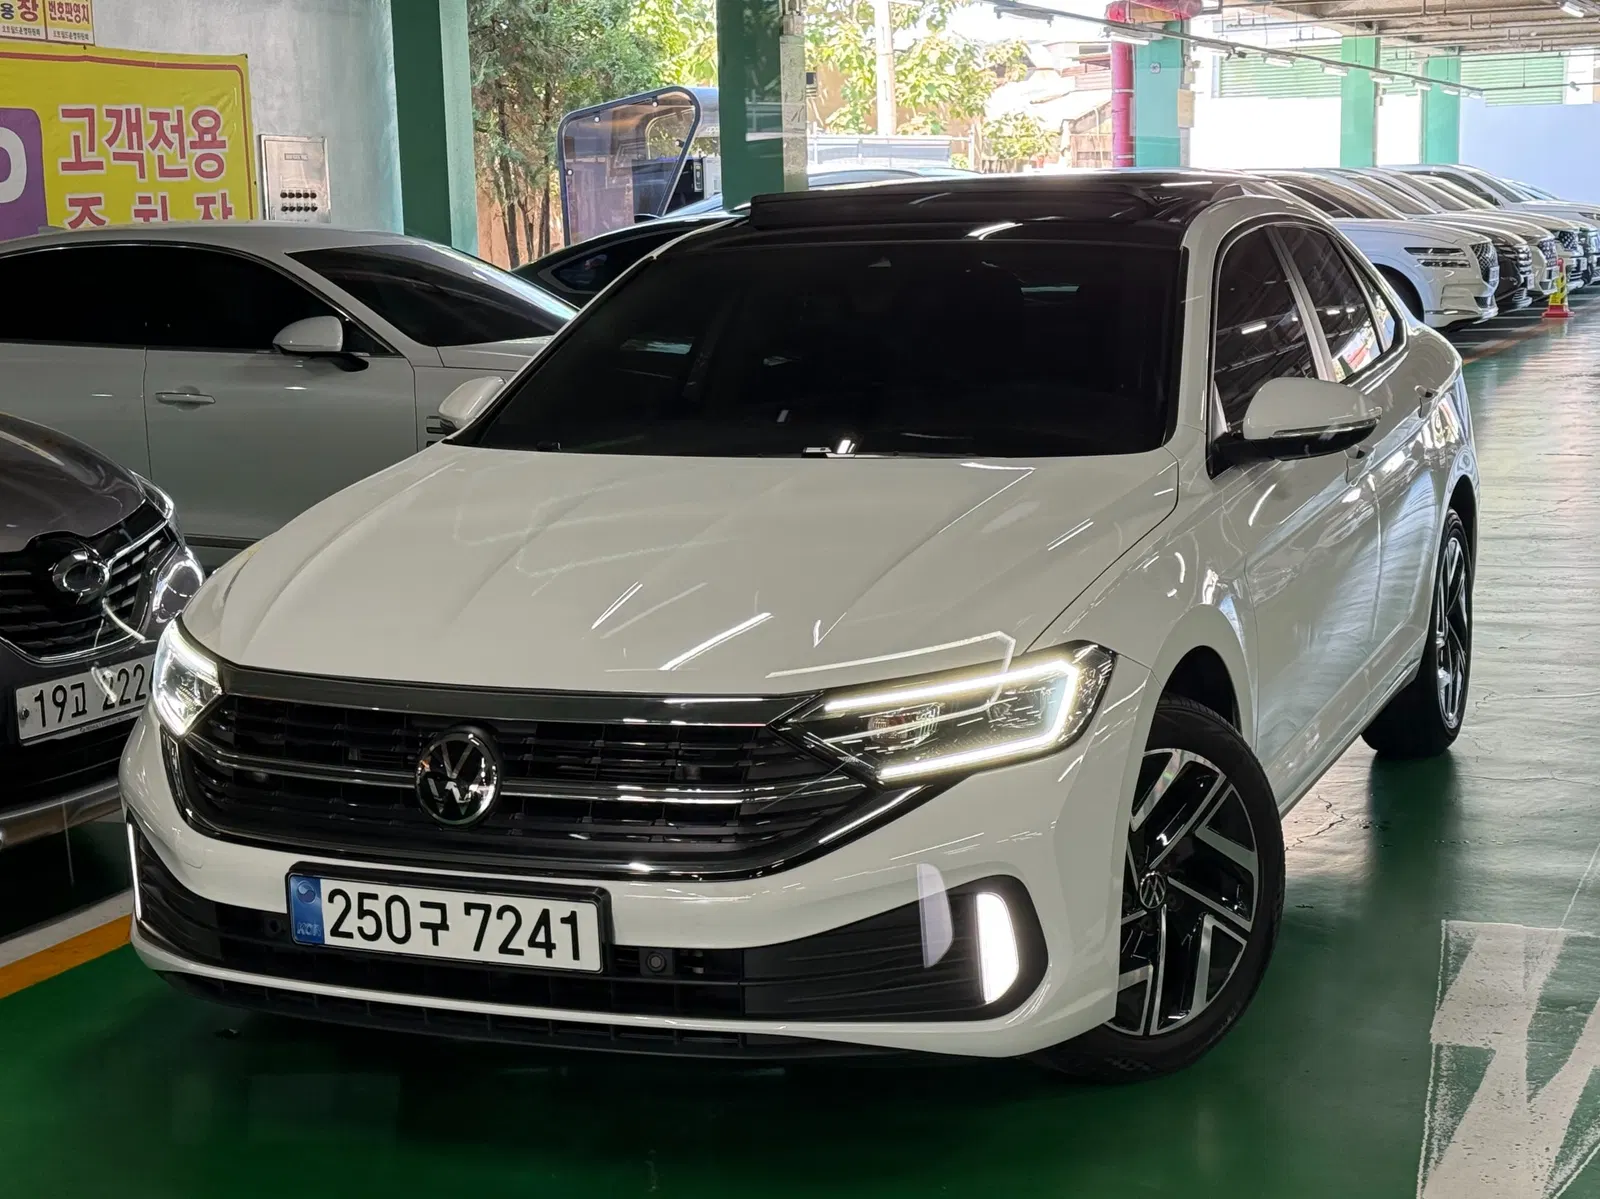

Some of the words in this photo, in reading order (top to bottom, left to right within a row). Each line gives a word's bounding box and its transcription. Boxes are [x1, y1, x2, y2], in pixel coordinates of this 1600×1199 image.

[60, 107, 227, 180] 고객전용
[34, 682, 88, 728] 19고
[102, 660, 155, 711] 222
[327, 888, 449, 946] 250구
[463, 901, 580, 961] 7241
